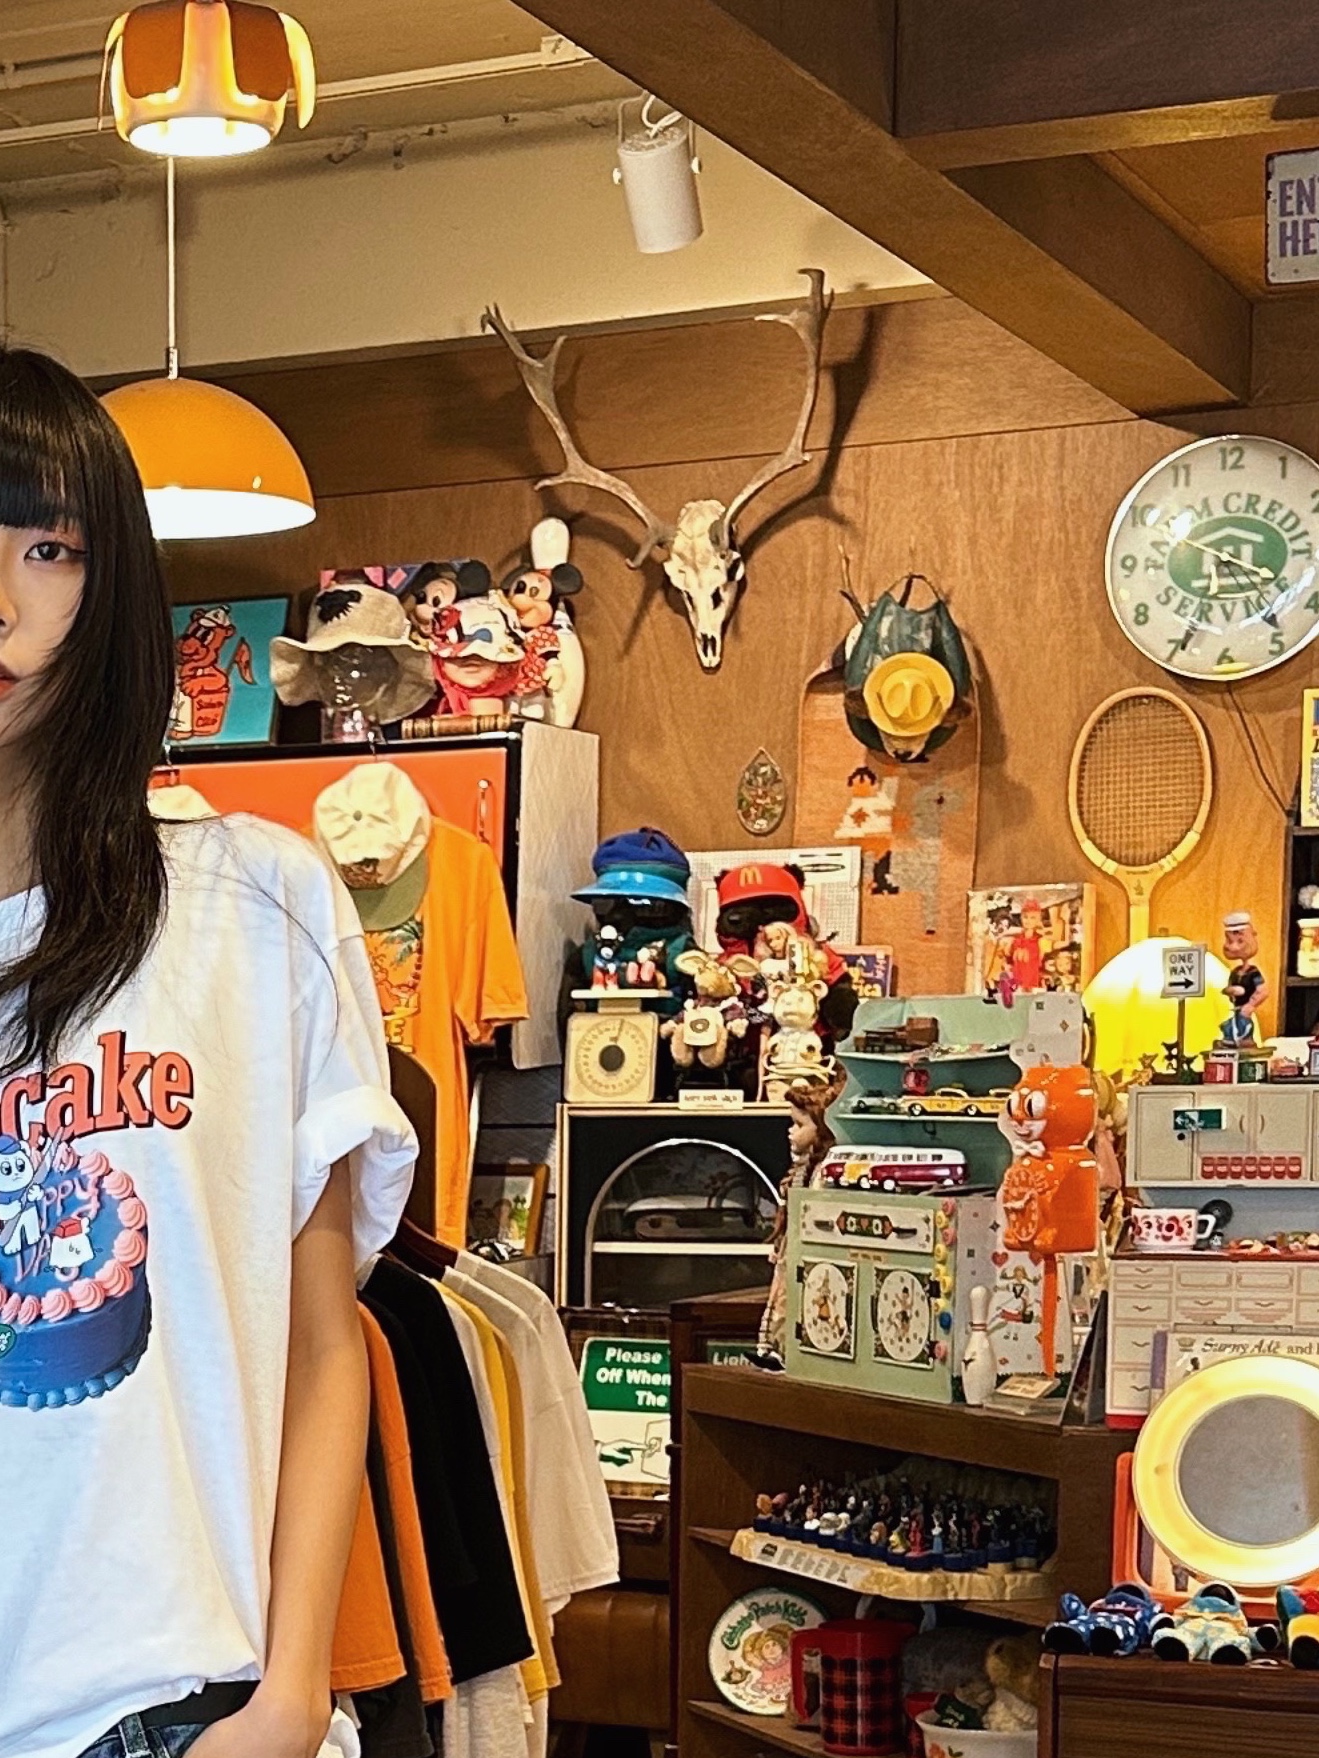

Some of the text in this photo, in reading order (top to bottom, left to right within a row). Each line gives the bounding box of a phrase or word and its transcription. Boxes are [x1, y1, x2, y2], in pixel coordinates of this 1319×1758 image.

[1218, 446, 1245, 470] 12
[1278, 456, 1288, 479] 1
[1171, 464, 1191, 487] 11
[1222, 491, 1313, 561] CREDIT
[1133, 603, 1149, 626] 8
[1169, 953, 1194, 964] ONE
[1169, 965, 1194, 976] WAY
[604, 1346, 663, 1365] Please
[595, 1367, 622, 1384] Off
[635, 1390, 668, 1407] The
